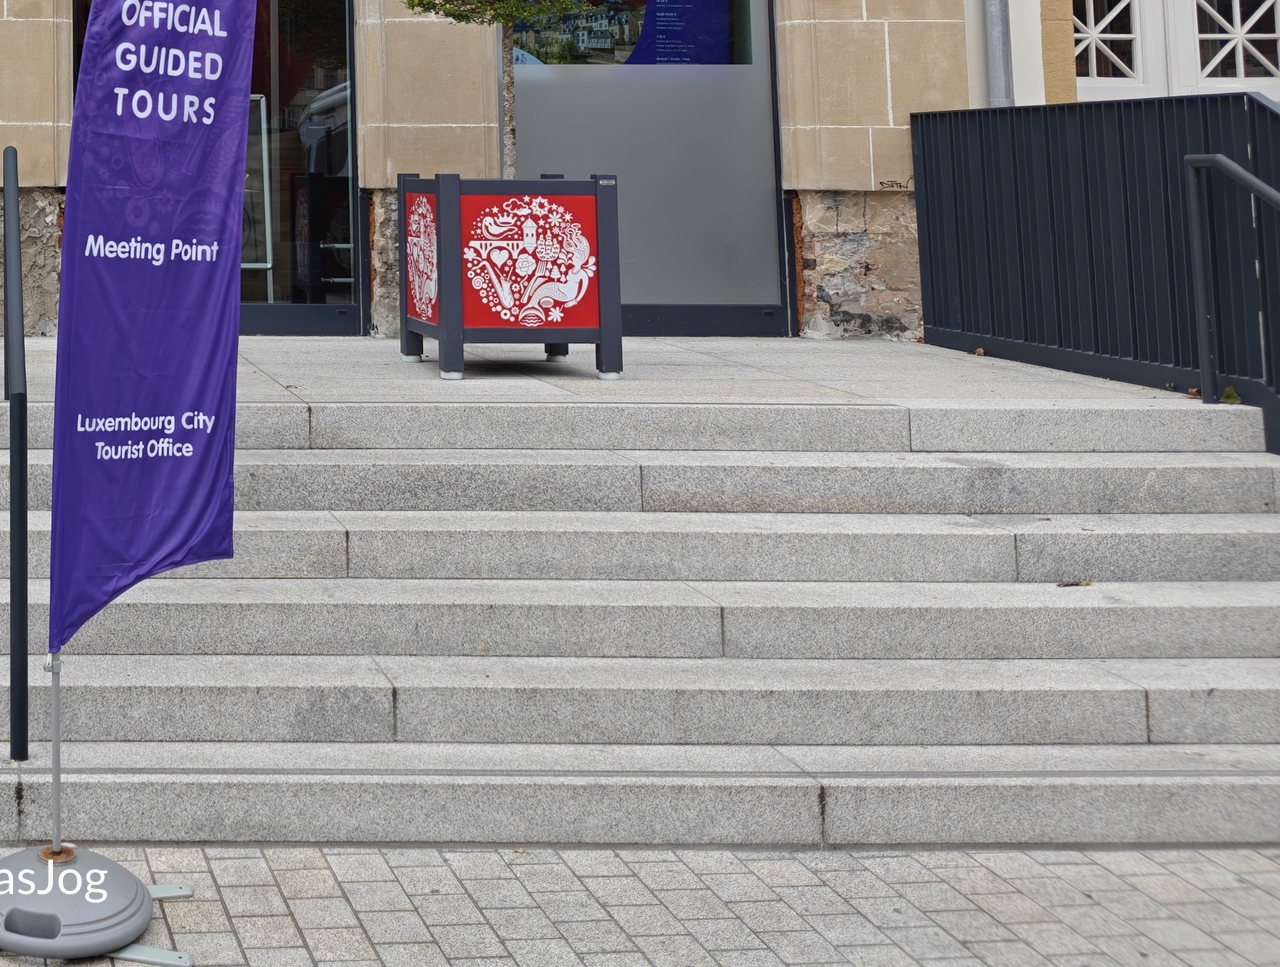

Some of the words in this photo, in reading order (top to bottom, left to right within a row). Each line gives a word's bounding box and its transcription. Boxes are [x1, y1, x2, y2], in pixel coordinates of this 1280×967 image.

[115, 41, 223, 81] GUIDED
[113, 87, 216, 125] TOURS
[84, 234, 165, 266] Meeting
[170, 238, 219, 262] Point
[77, 411, 176, 435] Luxembourg
[181, 410, 216, 434] City
[95, 440, 145, 460] Tourist
[146, 437, 194, 458] Office
